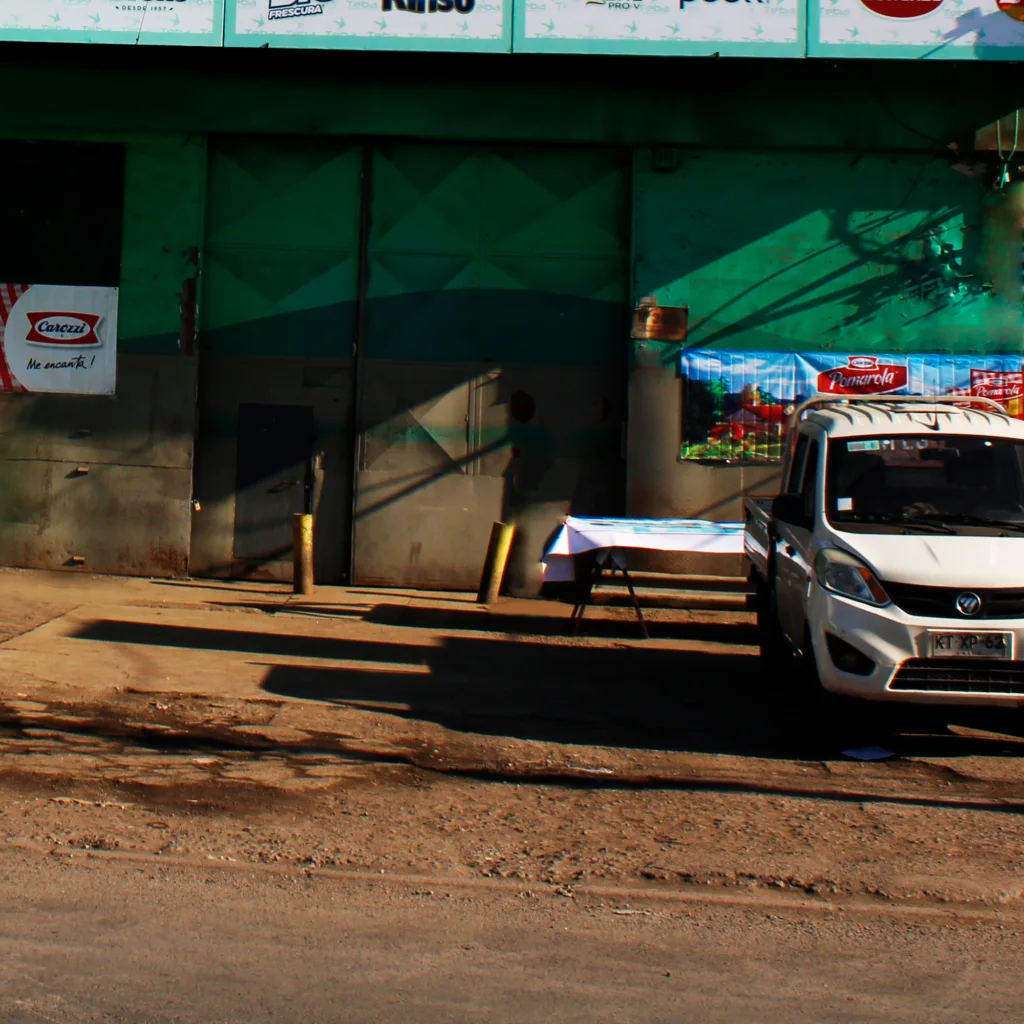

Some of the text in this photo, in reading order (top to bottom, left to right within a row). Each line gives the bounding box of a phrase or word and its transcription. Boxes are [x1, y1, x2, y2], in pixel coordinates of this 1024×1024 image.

[268, 4, 324, 20] FRESCURA
[38, 321, 86, 333] Carozzi
[26, 358, 41, 369] Me
[829, 367, 895, 390] Pomarola
